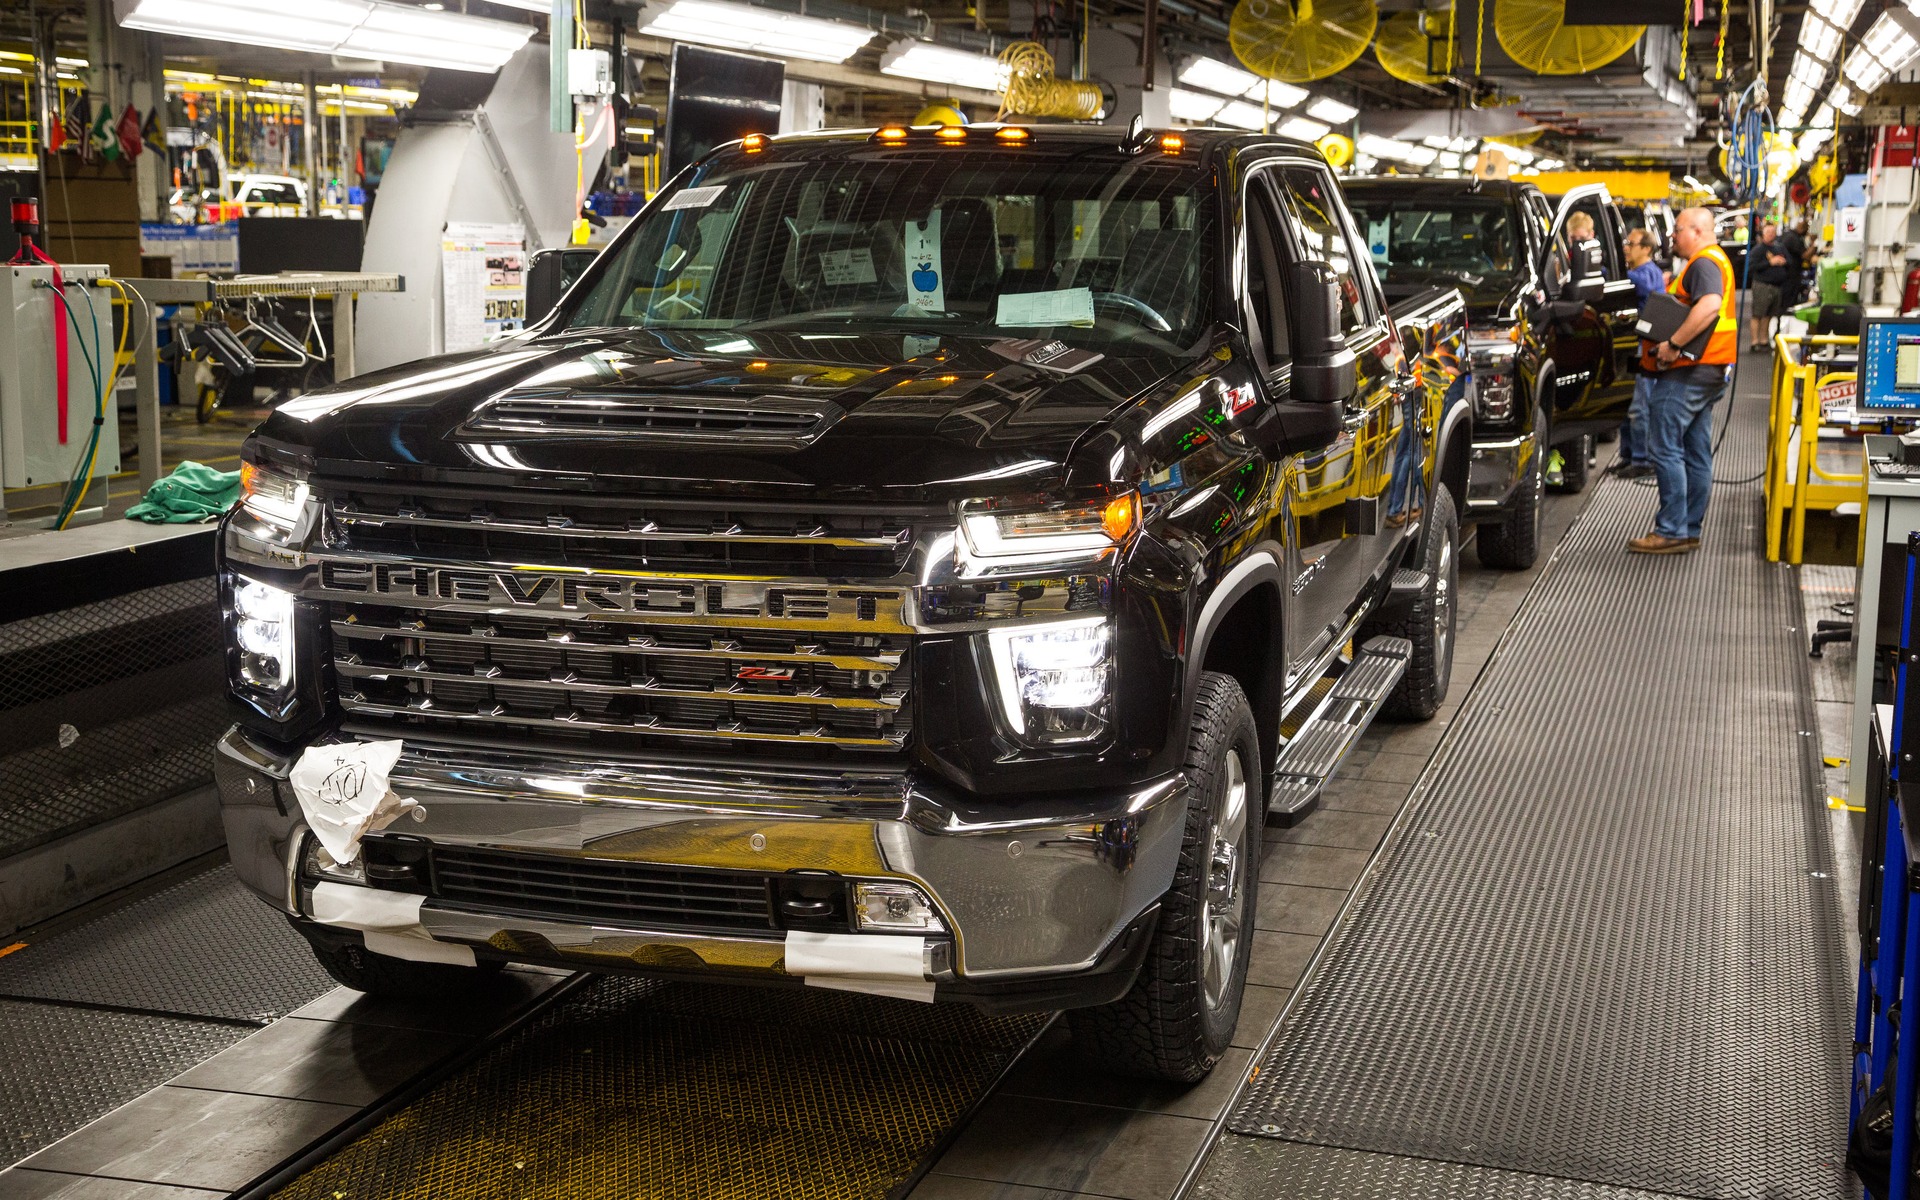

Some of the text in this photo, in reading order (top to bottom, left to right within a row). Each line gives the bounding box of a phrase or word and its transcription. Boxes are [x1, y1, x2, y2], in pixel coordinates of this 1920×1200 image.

[1821, 383, 1857, 400] NOTI
[317, 559, 902, 621] CHEVROLET
[736, 666, 796, 681] Z71
